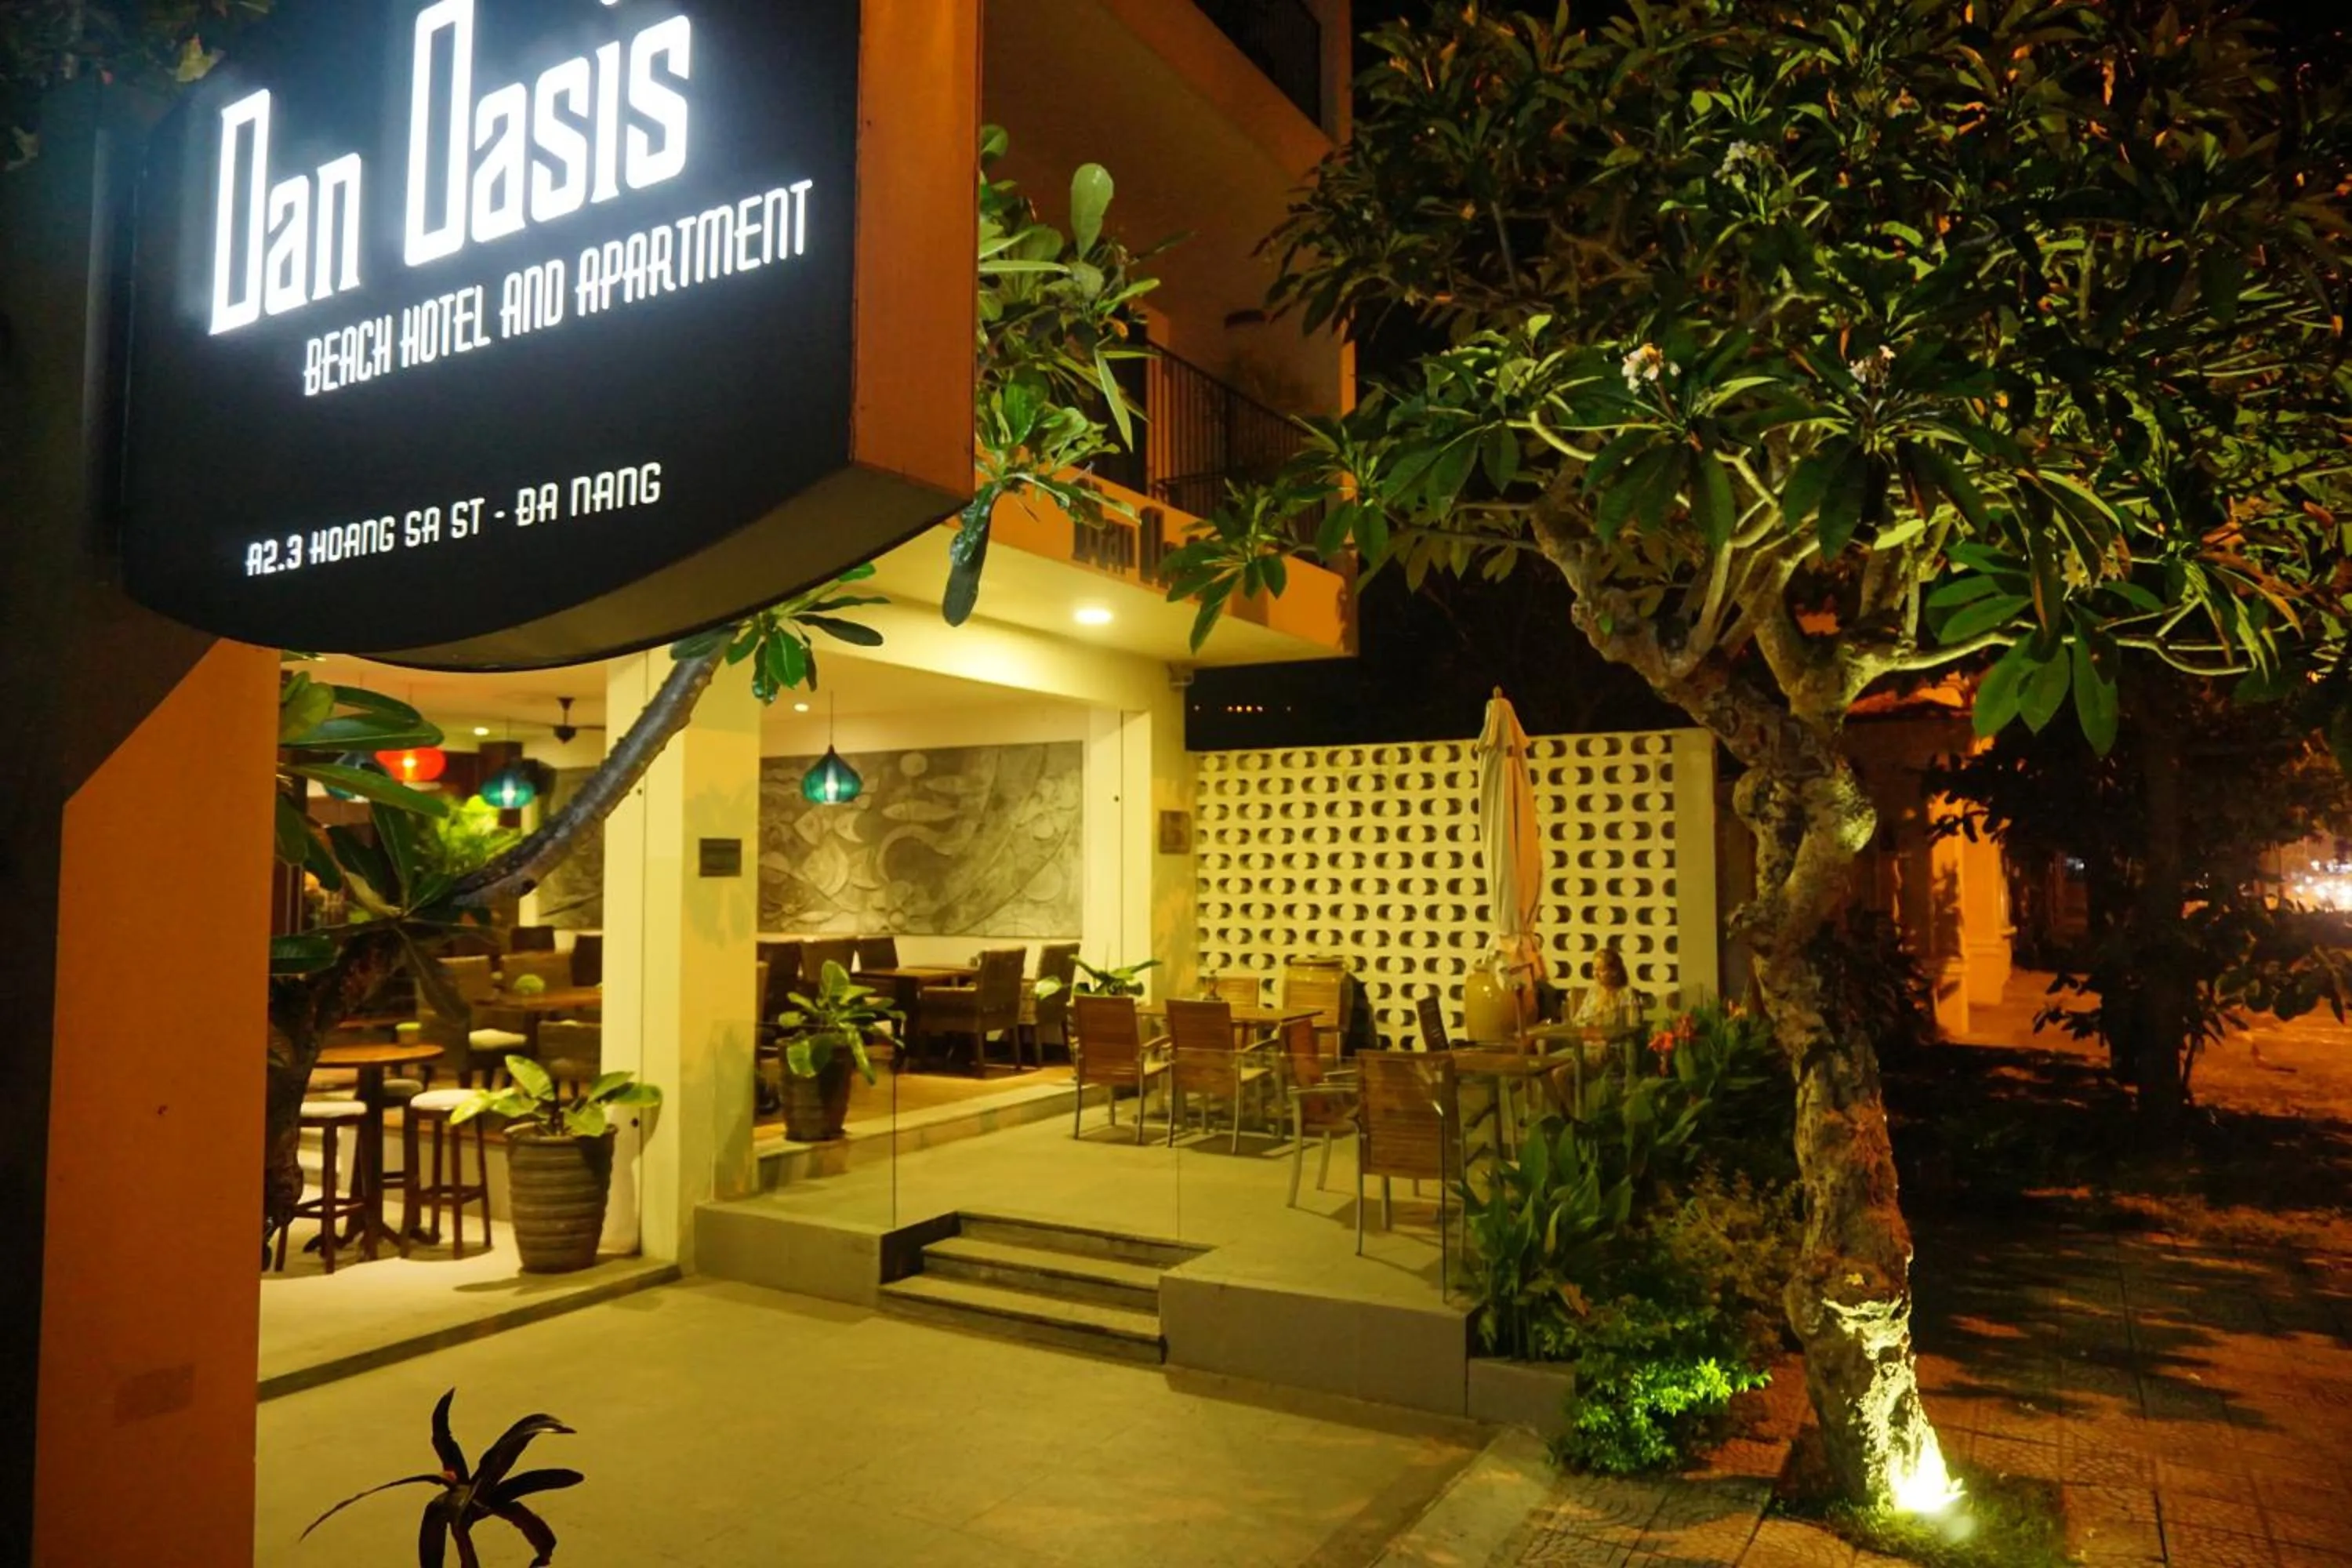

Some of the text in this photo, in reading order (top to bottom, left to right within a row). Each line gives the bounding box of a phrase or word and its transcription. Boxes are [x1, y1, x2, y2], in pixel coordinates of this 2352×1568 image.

[209, 0, 691, 336] Dan Oasis
[303, 180, 812, 396] BEACH HOTEL AND APARTMENT
[245, 535, 303, 576] A2.3
[310, 517, 394, 564] HOANG
[405, 507, 440, 547] SA
[451, 498, 485, 539] ST
[571, 463, 660, 517] NANG
